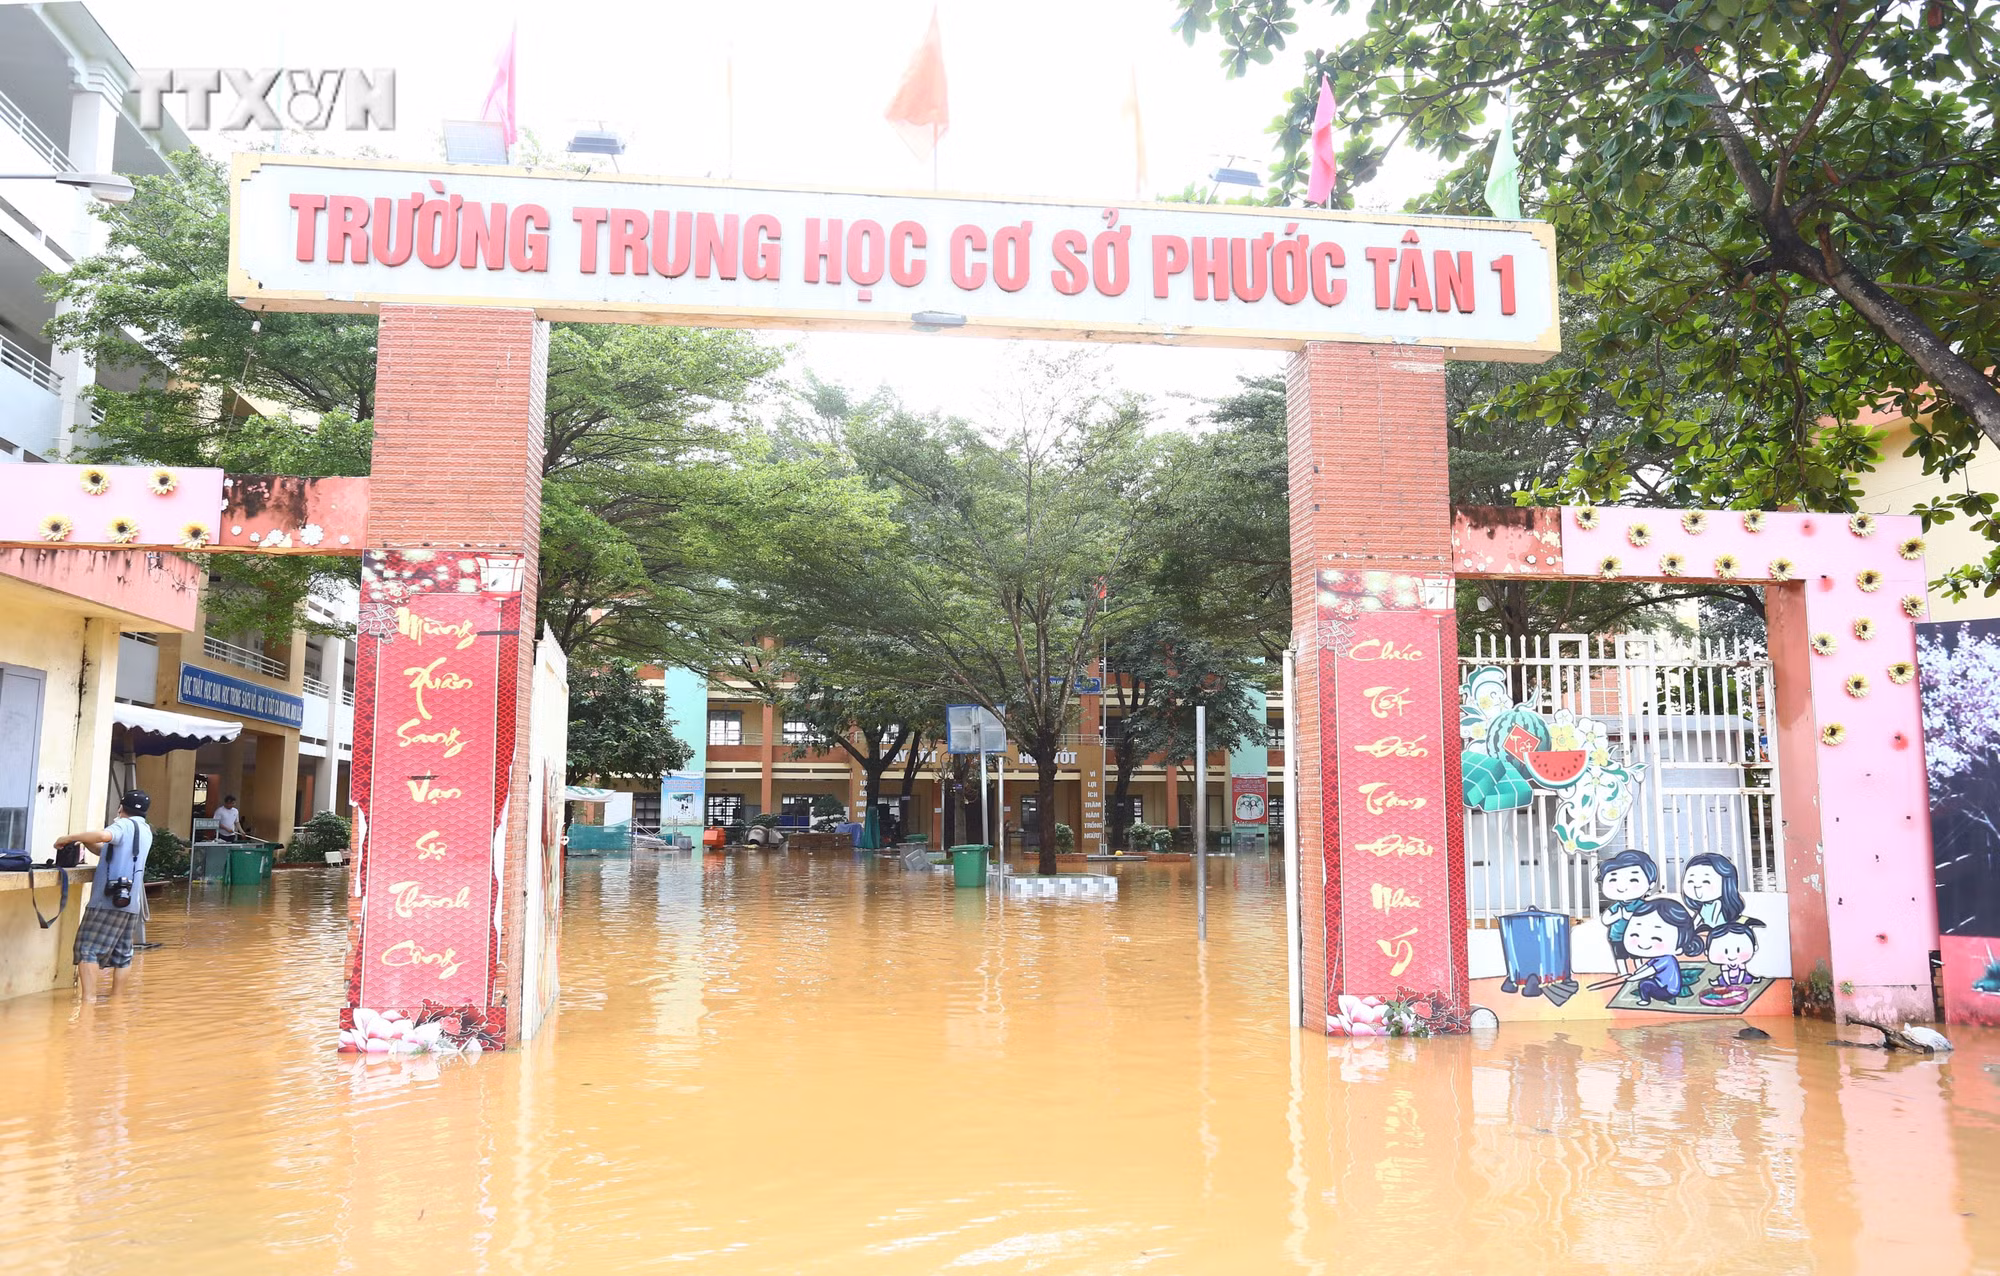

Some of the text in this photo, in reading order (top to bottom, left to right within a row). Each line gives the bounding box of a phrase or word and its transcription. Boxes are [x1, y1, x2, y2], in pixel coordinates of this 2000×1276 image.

[289, 180, 1517, 316] TRƯỜNG TRUNG HỌC CƠ SỞ PHƯỚC TÂN 1
[395, 606, 478, 650] Mừng
[1349, 638, 1428, 661] Chúc
[403, 657, 474, 720] Xuân
[1363, 686, 1416, 718] Tết
[397, 718, 475, 758] Sang
[1354, 734, 1429, 758] Đến
[1018, 751, 1037, 767] HỌ
[407, 770, 463, 804] Vạn
[1354, 834, 1434, 858] Điều
[388, 880, 471, 918] Thành
[381, 940, 472, 980] Công
[1376, 927, 1419, 977] Ý
